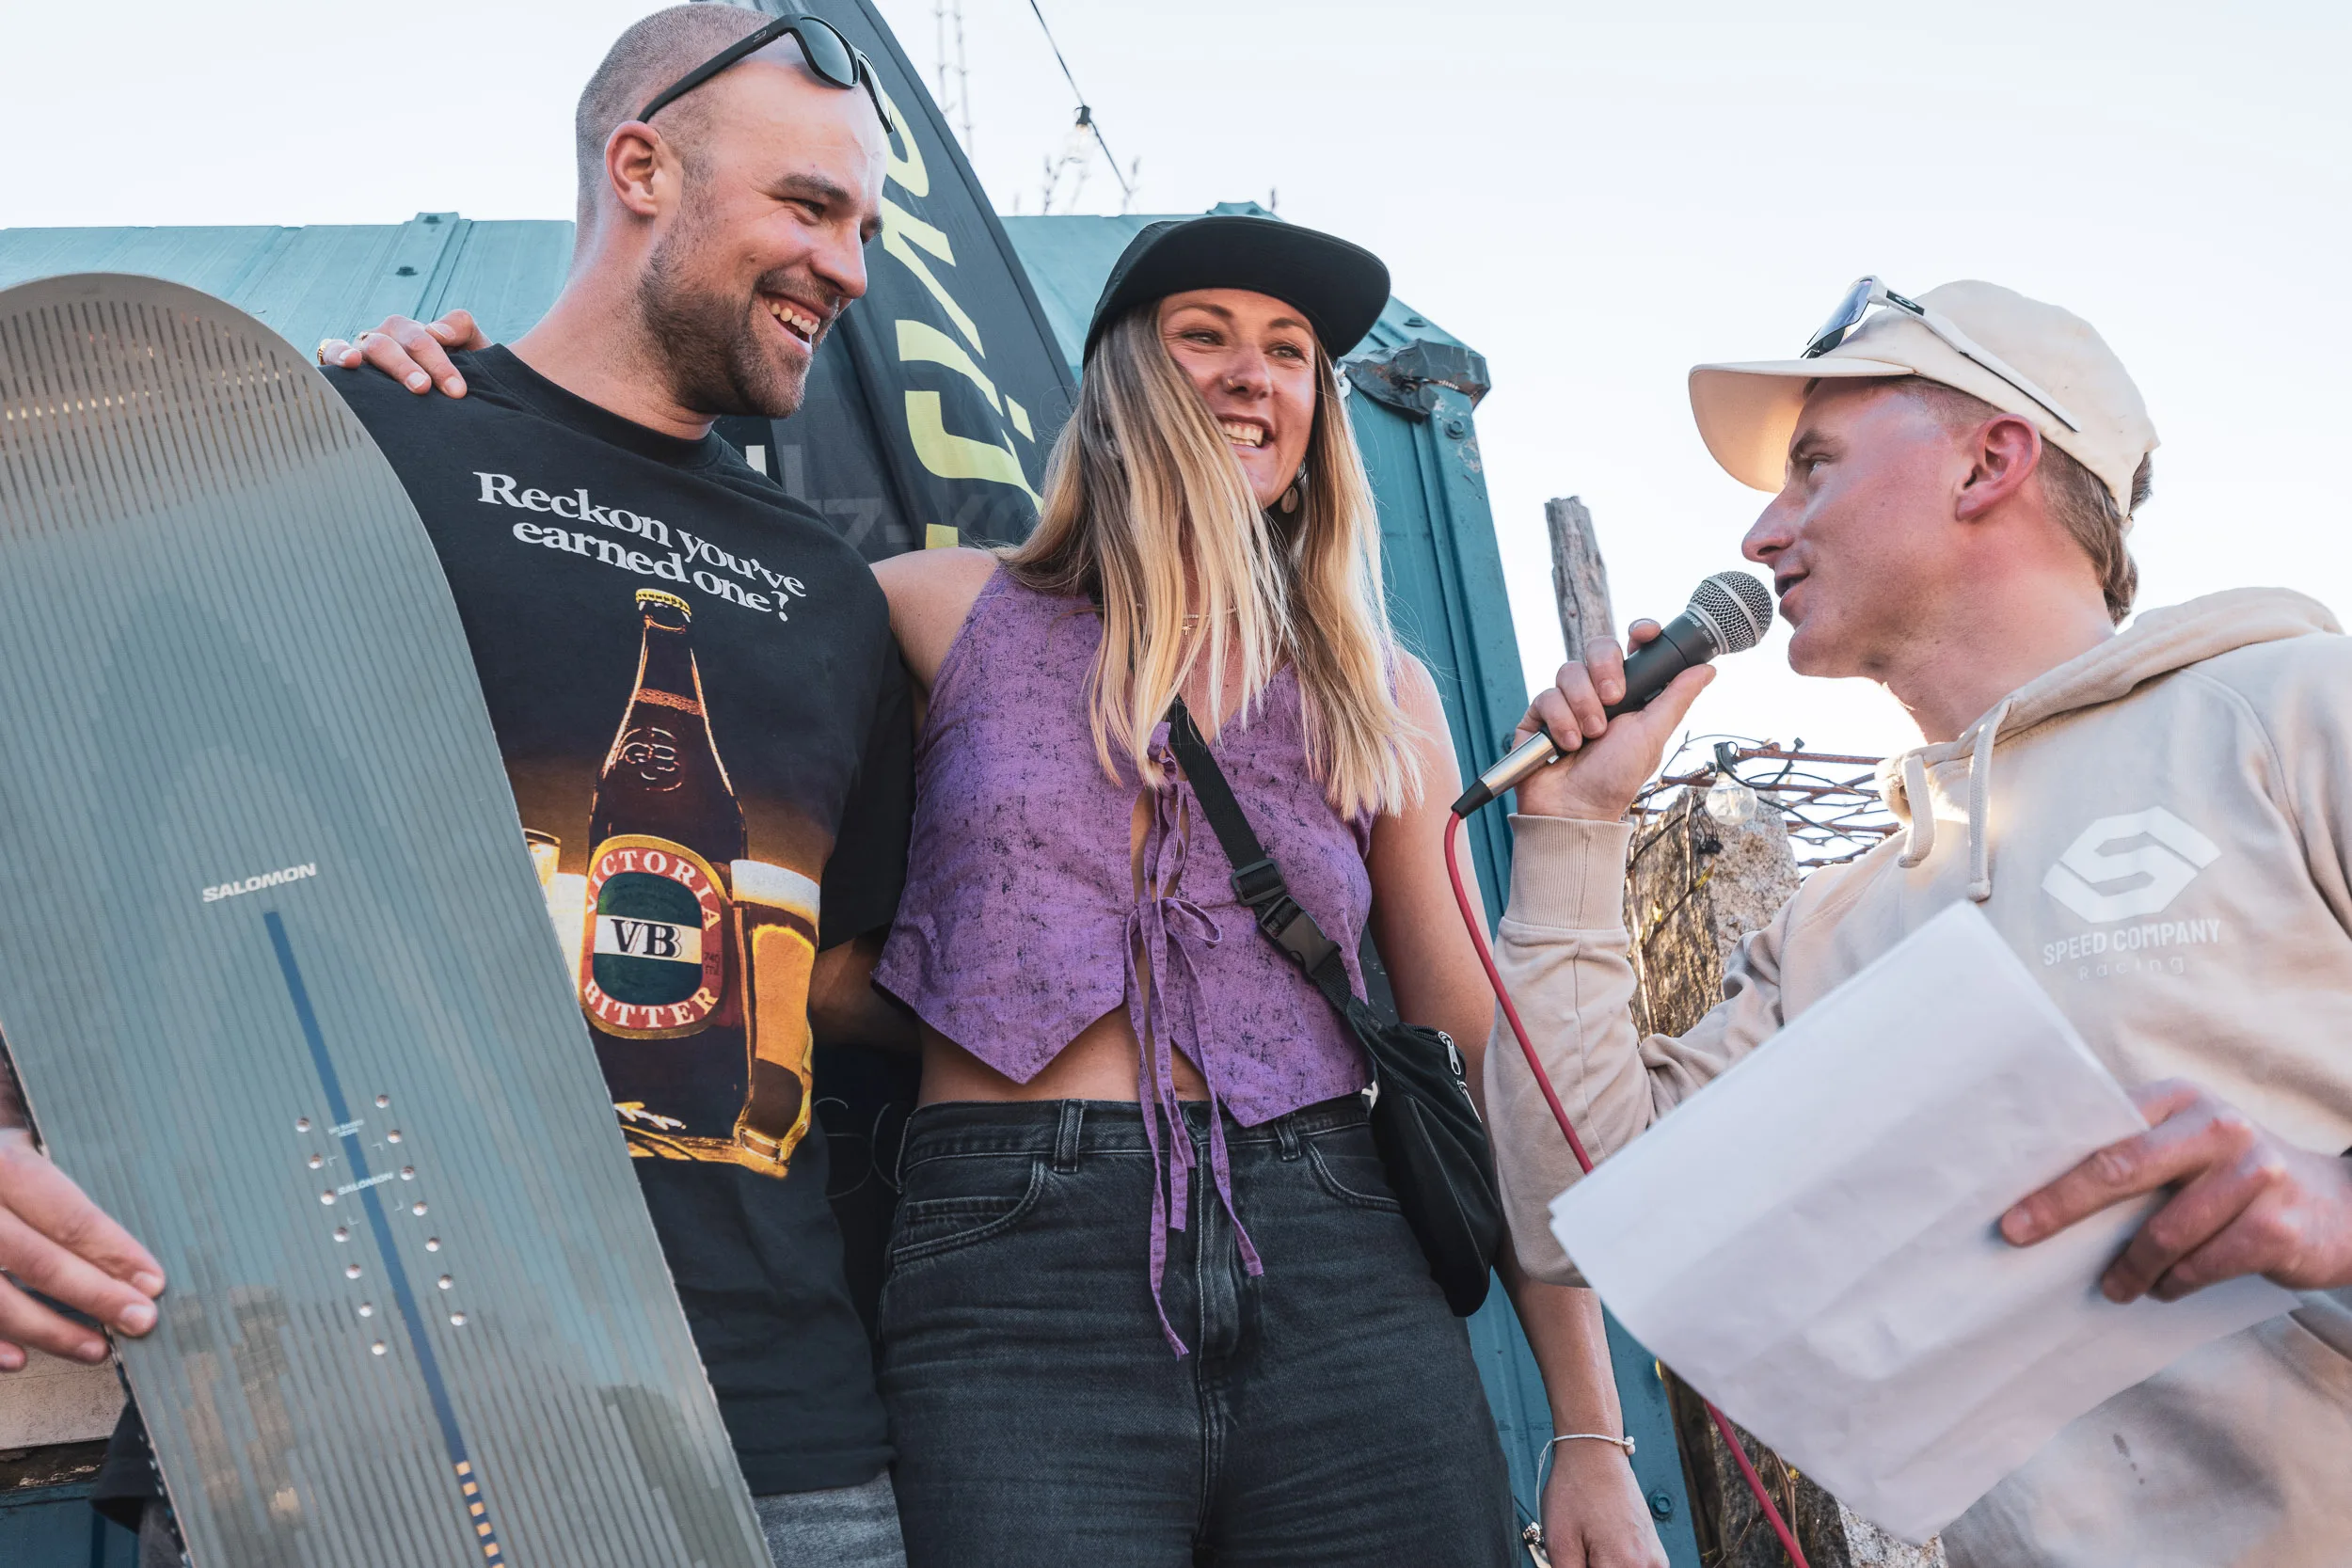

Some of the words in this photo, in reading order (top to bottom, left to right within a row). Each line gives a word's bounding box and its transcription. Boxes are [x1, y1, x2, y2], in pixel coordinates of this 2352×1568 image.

[472, 471, 673, 547] Reckon
[675, 528, 806, 597] you've
[513, 522, 690, 584] earned
[695, 571, 788, 622] one?
[202, 862, 316, 903] SALOMON
[585, 849, 722, 931] VICTORIA
[611, 917, 683, 959] VB
[2043, 932, 2107, 966] SPEED
[2113, 918, 2221, 952] COMPANY
[2078, 956, 2185, 981] Racing
[583, 979, 720, 1028] BITTER
[337, 1171, 394, 1196] SALOMON
